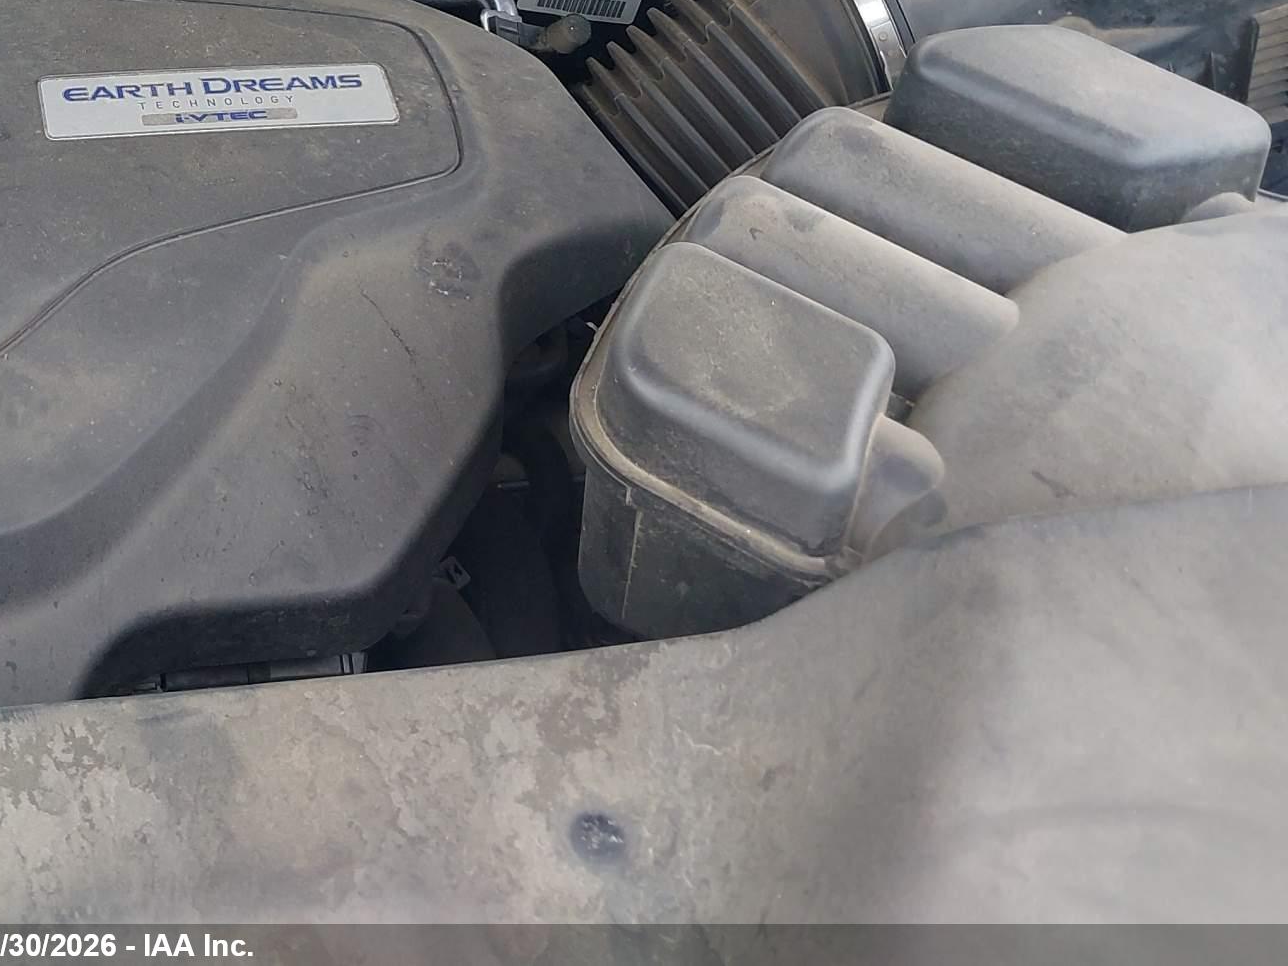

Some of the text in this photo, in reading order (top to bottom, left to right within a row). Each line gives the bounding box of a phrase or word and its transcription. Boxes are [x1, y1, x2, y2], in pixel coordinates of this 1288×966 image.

[63, 73, 363, 102] EARTH DREAMS
[139, 95, 294, 110] TECHNOLOGY
[175, 110, 268, 123] i-VTEC
